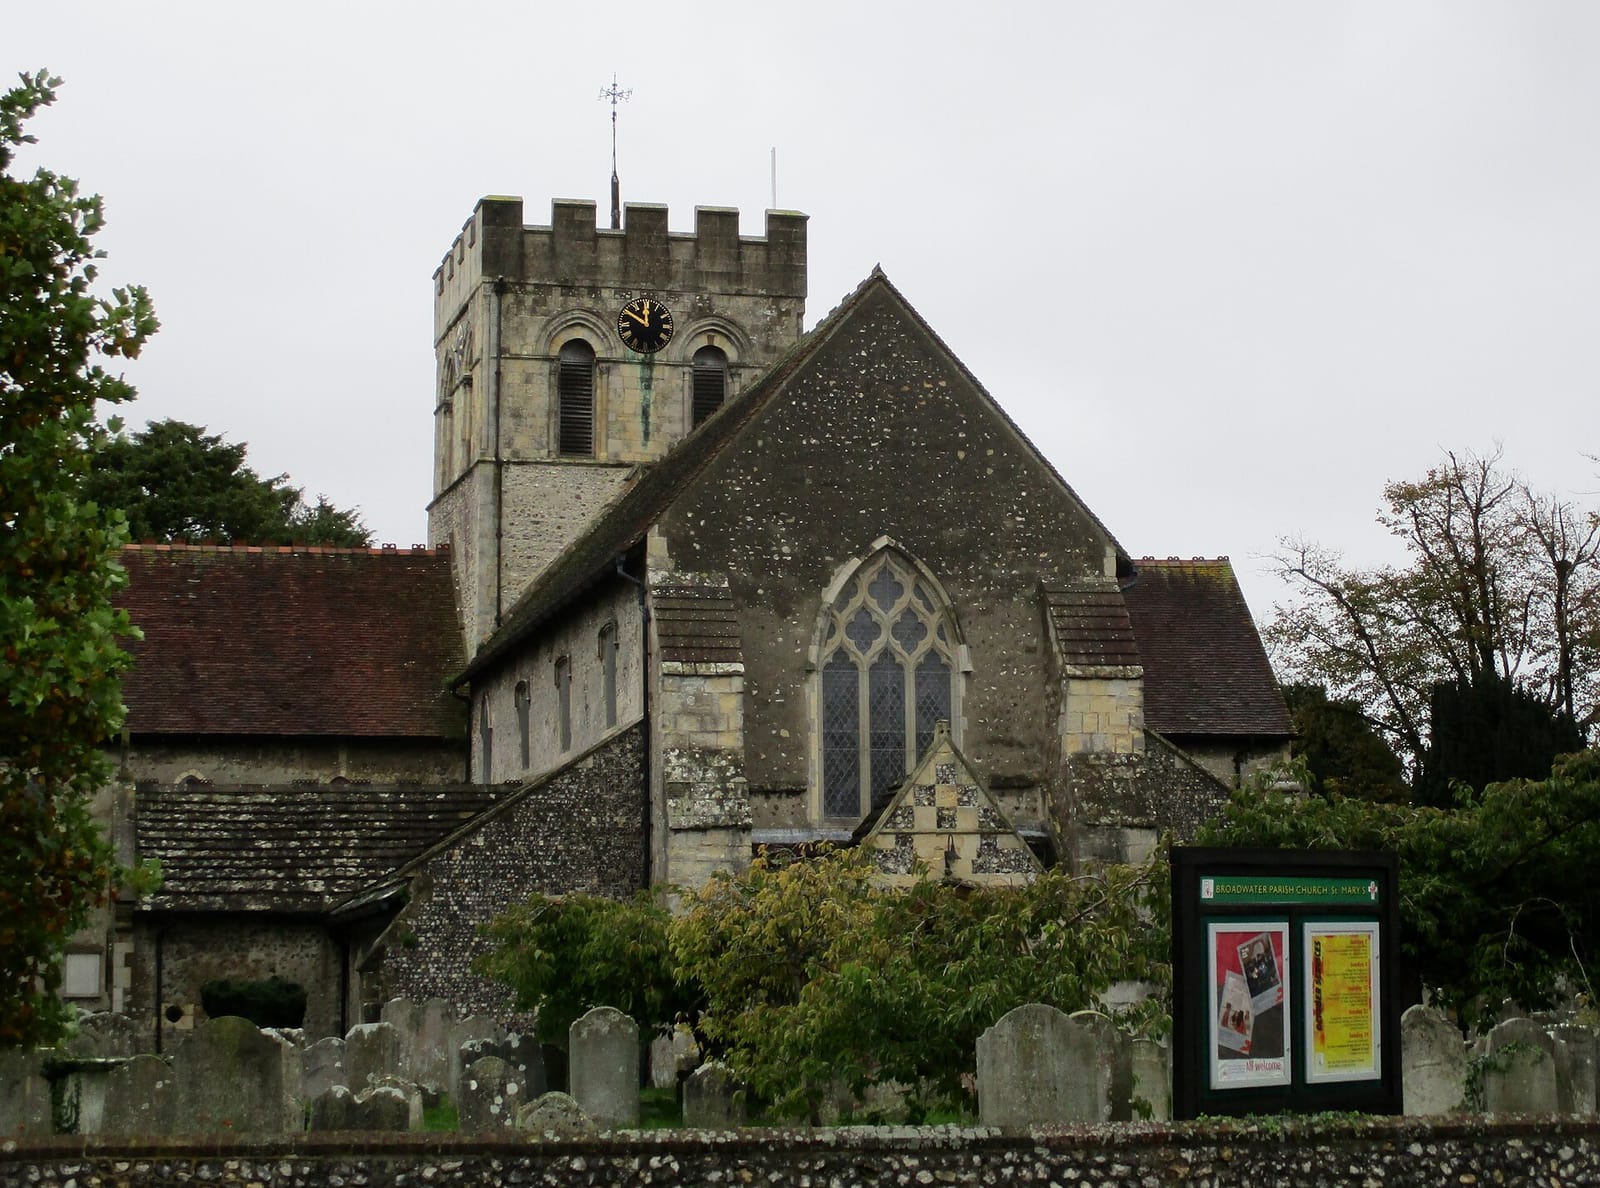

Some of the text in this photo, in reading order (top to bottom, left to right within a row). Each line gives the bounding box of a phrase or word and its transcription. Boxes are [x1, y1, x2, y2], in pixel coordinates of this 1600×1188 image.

[1215, 884, 1267, 894] BROADWATER
[1269, 884, 1294, 894] PARISH
[1296, 885, 1328, 895] CHURCH
[1314, 940, 1322, 985] SICES
[1255, 1060, 1281, 1071] welcome
